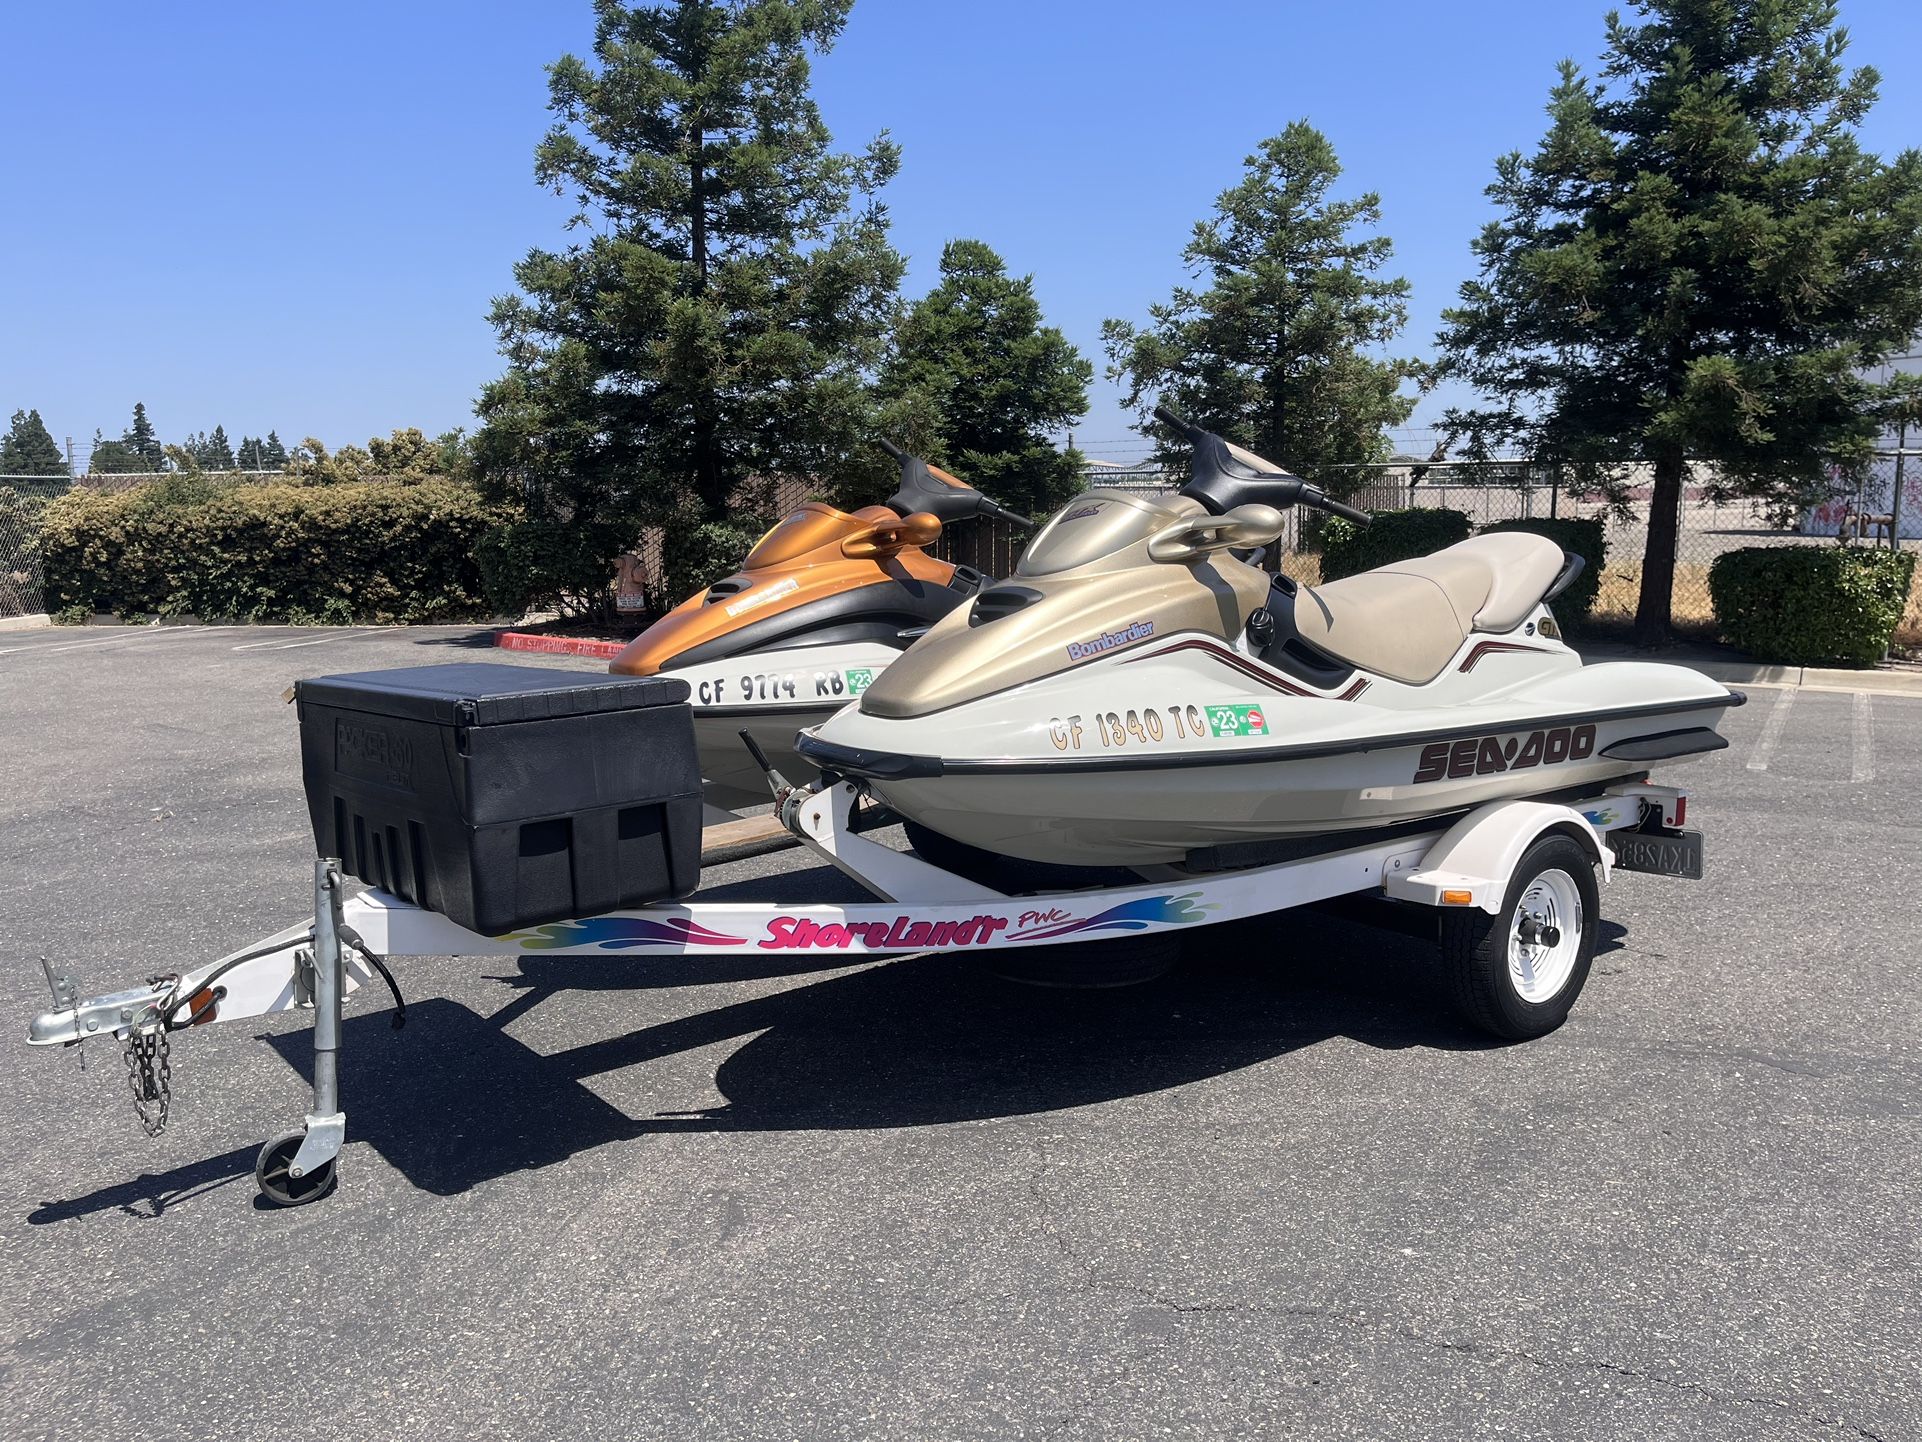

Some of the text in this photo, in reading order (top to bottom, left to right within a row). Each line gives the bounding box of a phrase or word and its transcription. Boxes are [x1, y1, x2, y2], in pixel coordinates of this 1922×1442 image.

[511, 637, 524, 649] NO
[577, 643, 597, 655] FIRE
[601, 646, 622, 655] LAN
[1066, 621, 1154, 661] Bombardier
[699, 678, 725, 705] CF
[813, 670, 844, 697] RB
[855, 673, 873, 689] 23
[1049, 704, 1205, 750] CF 1340 TC
[1216, 710, 1239, 730] 23
[1017, 907, 1072, 928] PWC
